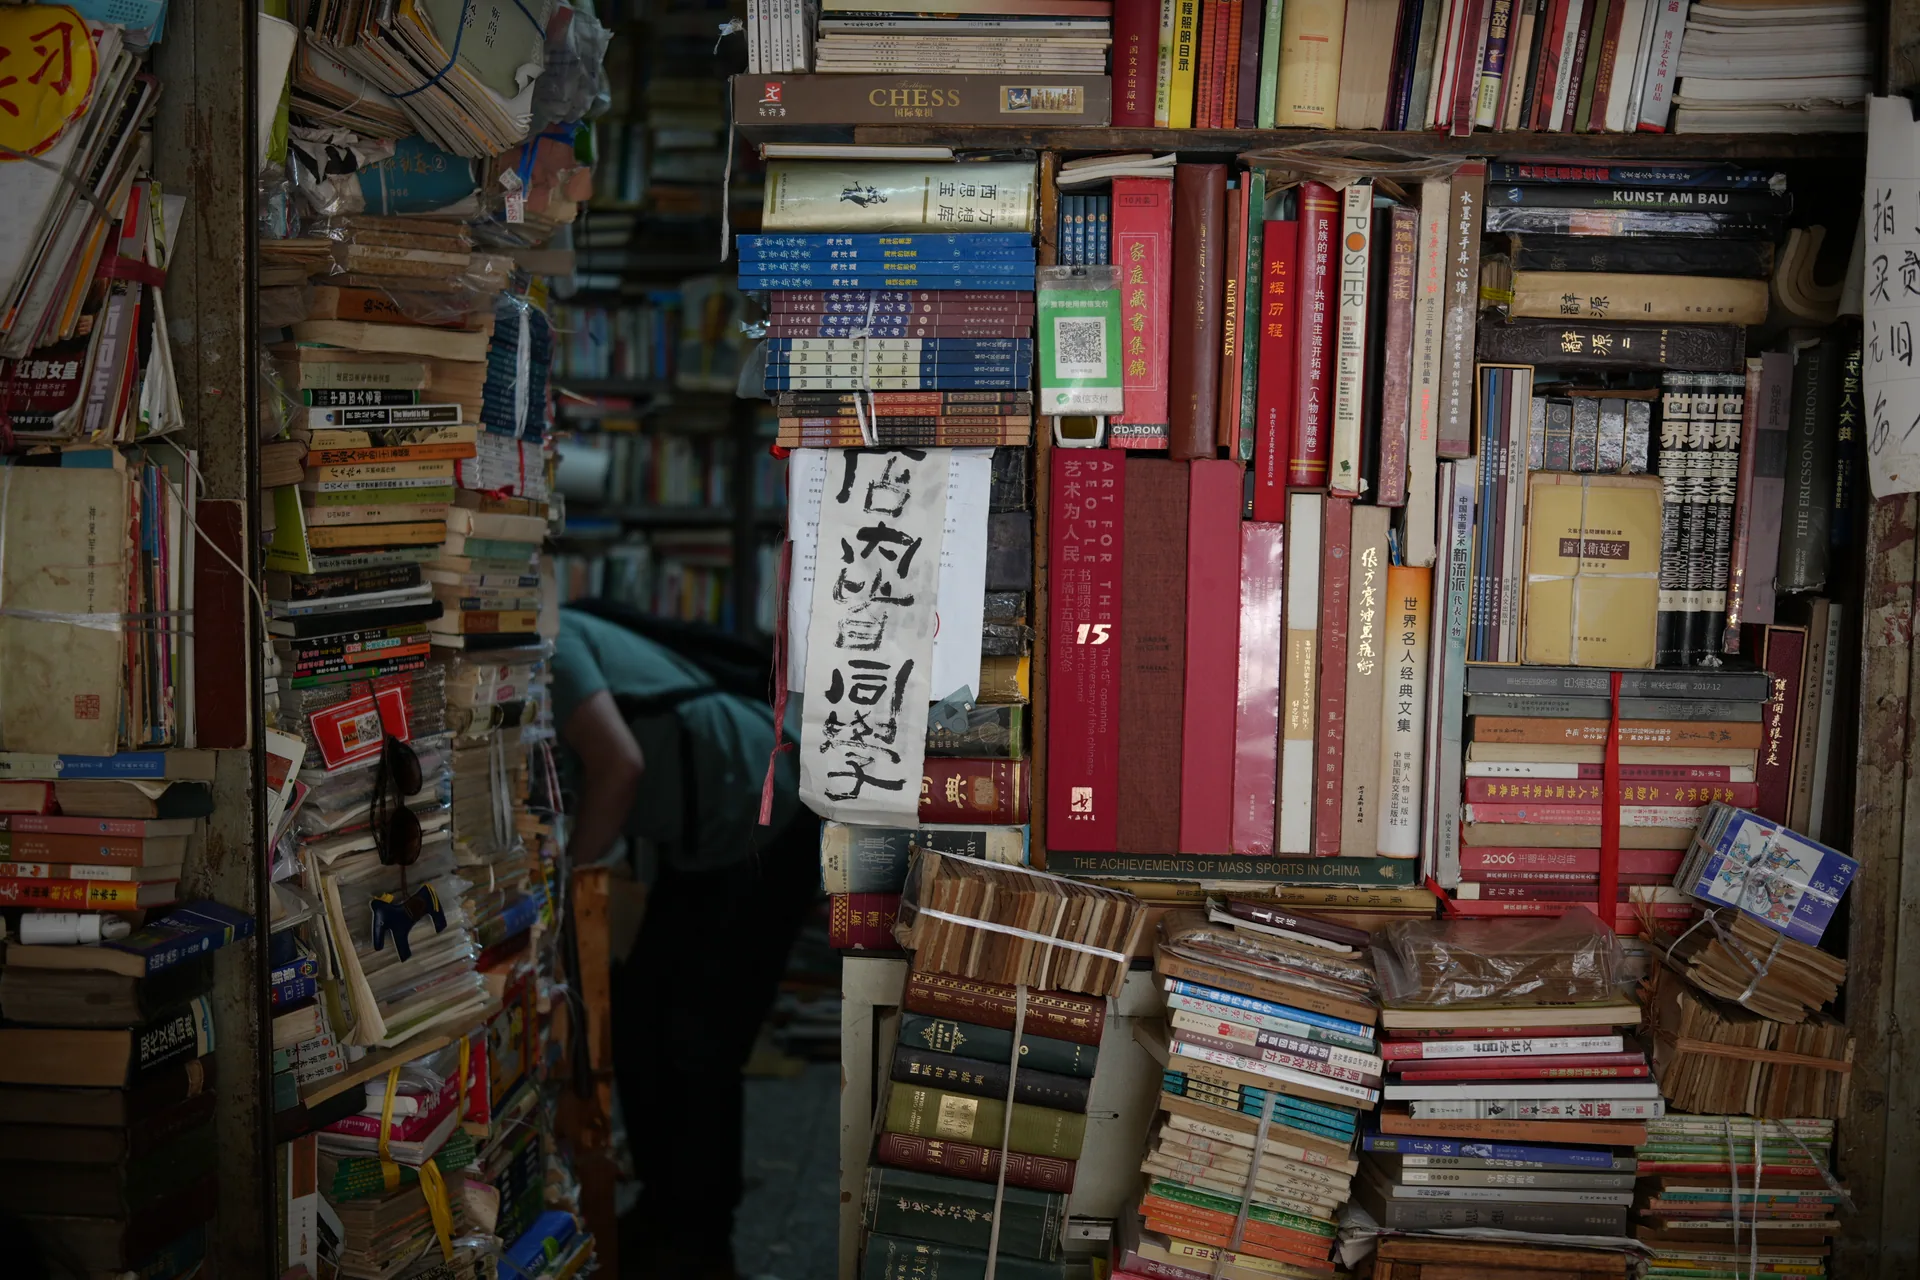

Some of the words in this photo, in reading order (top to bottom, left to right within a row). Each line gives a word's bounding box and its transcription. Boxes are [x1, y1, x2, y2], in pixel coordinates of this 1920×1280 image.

[1178, 0, 1193, 71] 程照明目录
[1125, 34, 1139, 111] 中国文史出版社
[869, 89, 961, 107] CHESS
[894, 108, 933, 118] 国际象棋
[1612, 191, 1664, 203] KUNST
[1668, 193, 1693, 204] AM
[1698, 194, 1729, 205] BAU
[1342, 216, 1368, 307] POSTER
[1392, 220, 1415, 300] 辉煌的上海之夜
[830, 291, 904, 302] 唐诗宋元曲
[1226, 279, 1237, 318] ALBUM
[1267, 261, 1287, 338] 光辉历程
[824, 326, 898, 337] 唐诗元曲
[1224, 319, 1235, 356] STAMP
[15, 361, 77, 381] 红都女皇
[1072, 393, 1109, 404] 微信支付
[1803, 355, 1820, 438] CHRONICLE
[1112, 425, 1162, 437] CD-ROM
[1101, 461, 1114, 502] ART
[1800, 440, 1815, 508] ERICSSON
[1062, 460, 1081, 563] 艺术为人民
[1084, 461, 1097, 563] PEOPLE
[1456, 496, 1469, 546] 中国书画艺术
[1797, 511, 1809, 539] THE
[1100, 520, 1113, 563] FOR
[1451, 548, 1467, 592] 新流派
[1663, 551, 1678, 589] TYCOONS
[1689, 551, 1704, 589] TYCOONS
[1714, 551, 1729, 589] TYCOONS
[1077, 569, 1092, 621] 书画频道
[1099, 581, 1112, 620] THE
[1076, 623, 1112, 645] 15
[1451, 595, 1463, 638] 代表人物
[1102, 648, 1111, 665] The
[1396, 596, 1418, 733] 世界名人经典文集
[1073, 857, 1097, 869] THE
[1100, 858, 1195, 872] ACHIEVEMENTS
[1198, 861, 1214, 872] OF
[1218, 861, 1252, 873] MASS
[1255, 862, 1304, 875] SPORTS
[1307, 863, 1320, 876] IN
[1322, 863, 1361, 877] CHINA
[1482, 852, 1516, 865] 2006
[1263, 1047, 1362, 1086] 男性病实效良方
